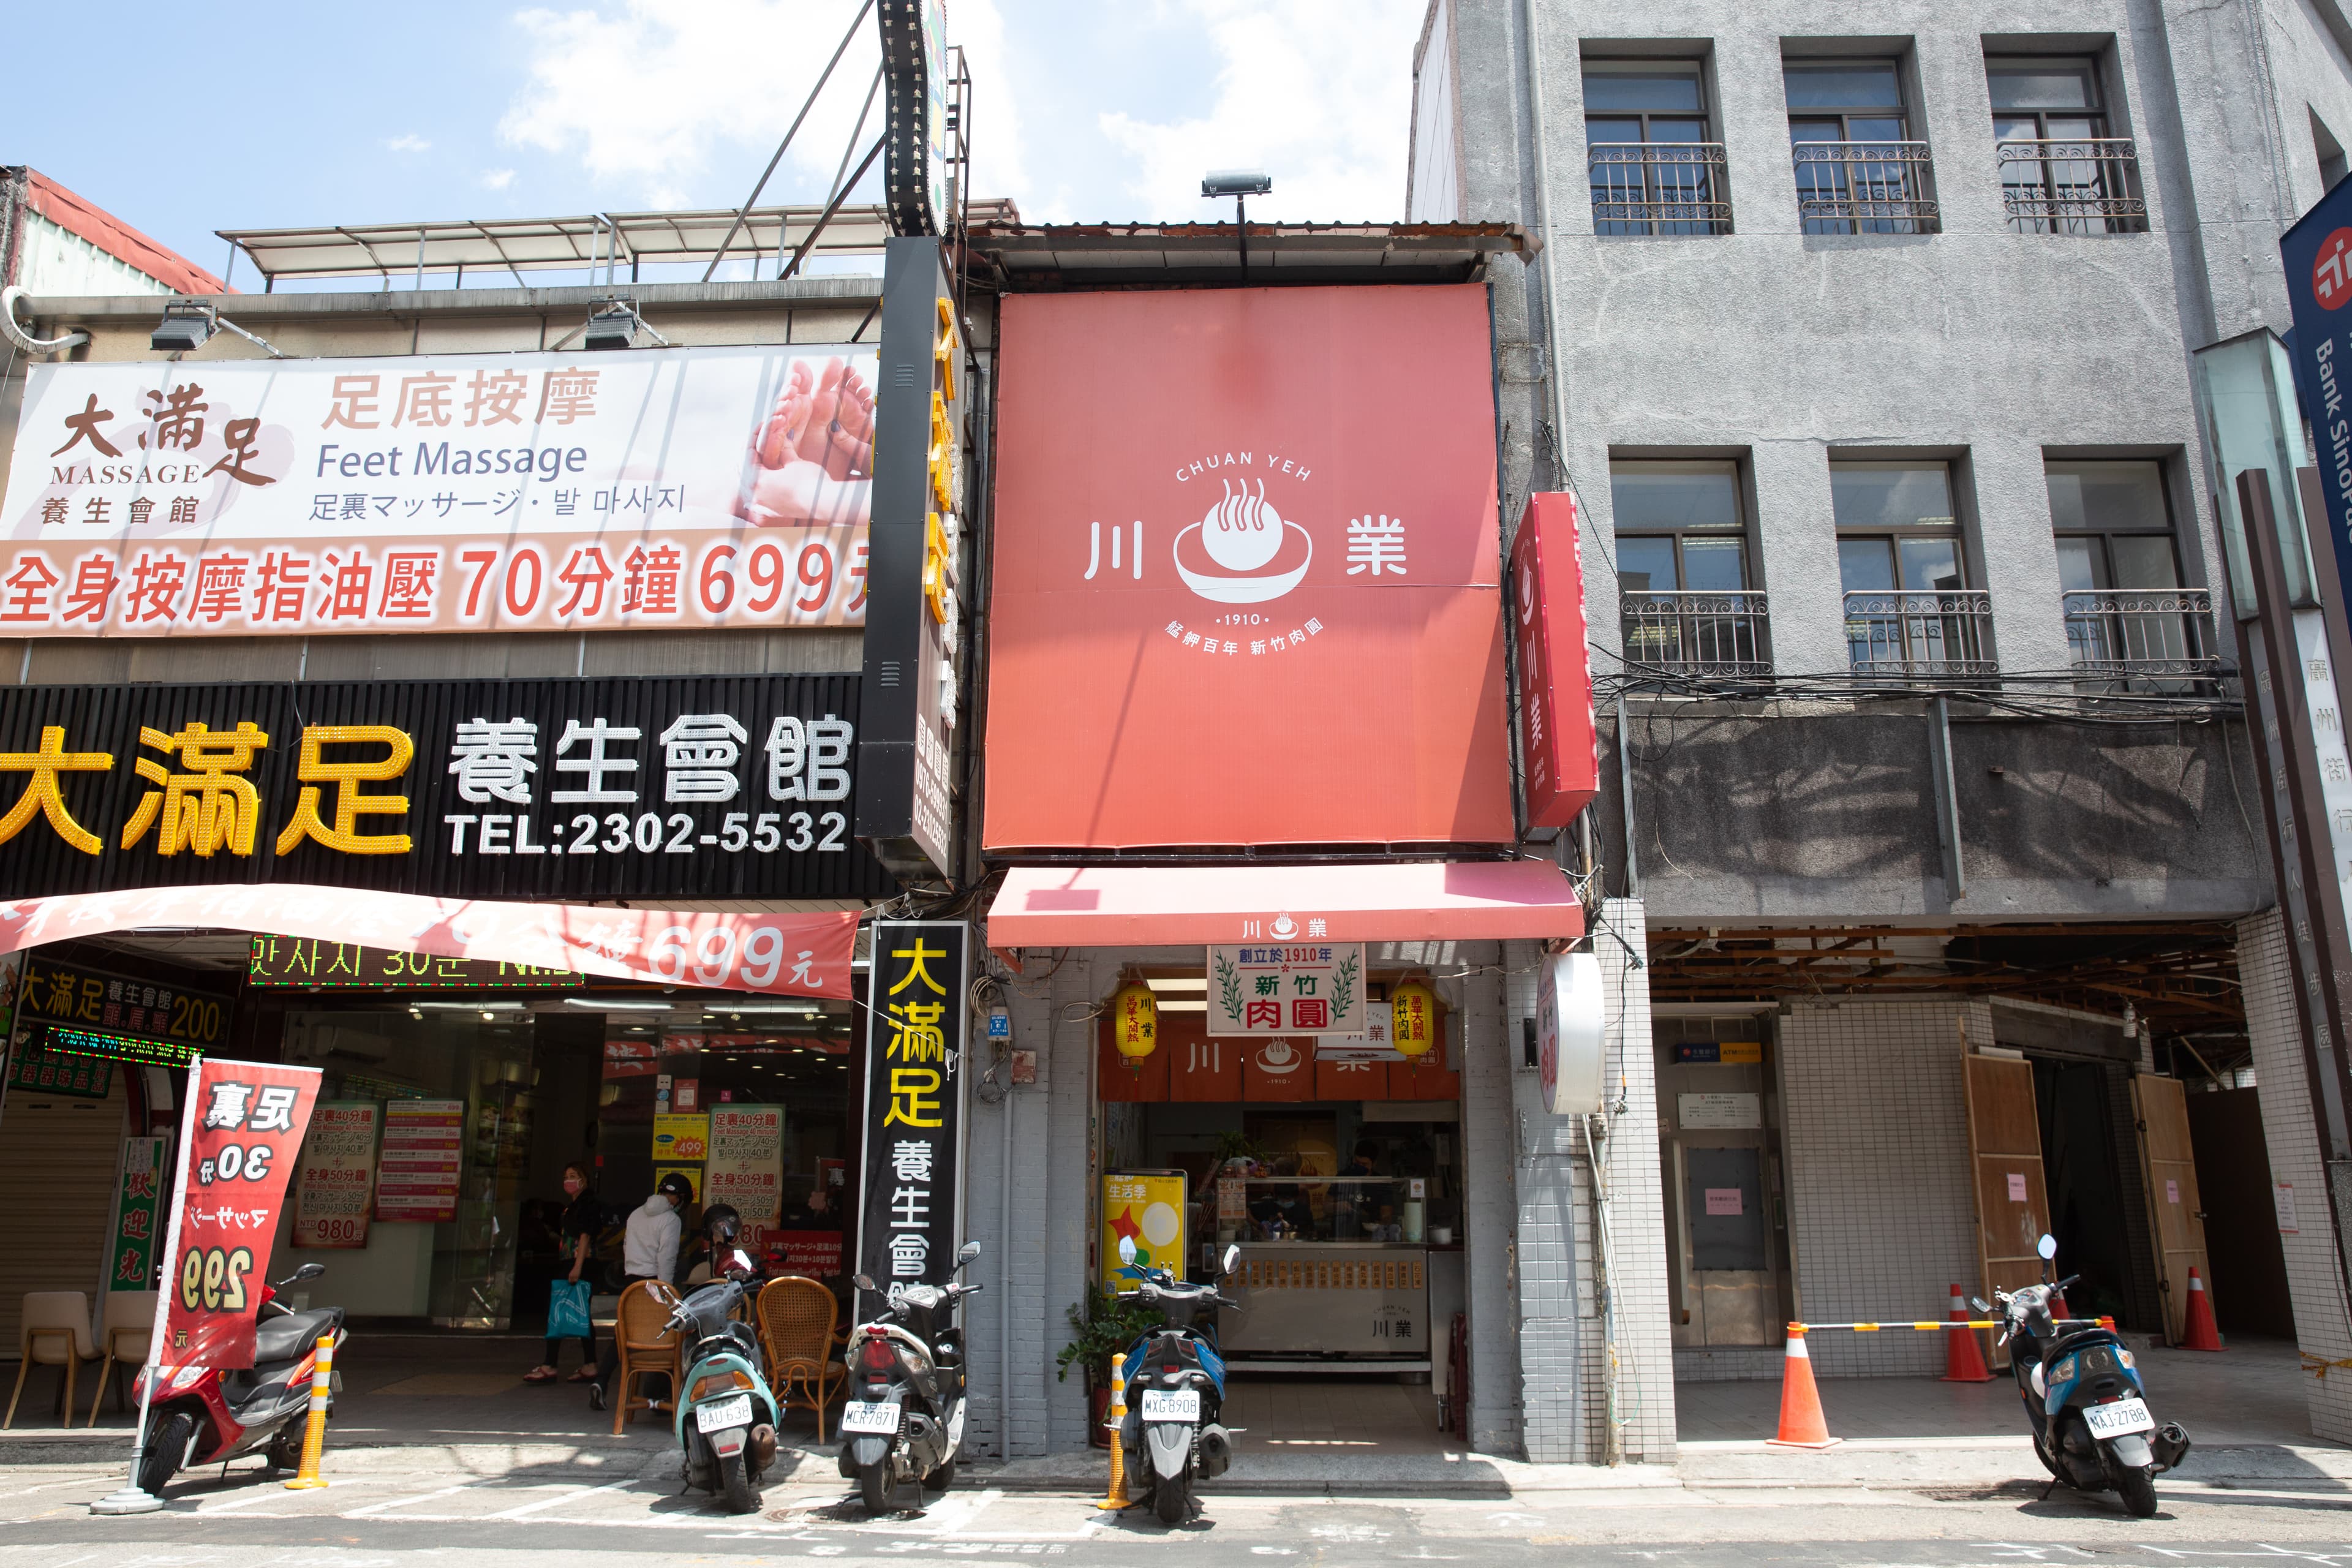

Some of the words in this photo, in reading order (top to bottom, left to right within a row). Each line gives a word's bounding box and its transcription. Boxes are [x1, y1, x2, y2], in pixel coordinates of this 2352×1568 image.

[2316, 337, 2342, 420] Bank
[320, 366, 600, 430] 足底按摩
[50, 383, 277, 486] 大滿足
[50, 465, 201, 484] MASSAGE
[317, 442, 401, 478] Feet
[413, 441, 587, 482] Massage
[1176, 451, 1252, 482] CHUAN
[1268, 454, 1311, 482] YEH
[40, 496, 200, 526] 養生會館
[593, 484, 685, 514] 마사지
[1164, 619, 1238, 656] 艋舺百年
[1250, 616, 1324, 655] 新竹肉圓
[448, 714, 853, 805] 養生會館
[0, 721, 414, 856] 大滿足
[444, 812, 847, 855] TEL:2302-5532
[1238, 948, 1332, 963] 創立於1910年
[20, 967, 104, 1022] 大滿足
[108, 979, 172, 1010] 養生會館
[1256, 975, 1317, 995] 新竹
[169, 995, 219, 1042] 200
[1247, 999, 1328, 1028] 肉圓
[884, 938, 946, 1128] 大滿足
[312, 1109, 373, 1122] 足裏40分鐘
[715, 1113, 778, 1127] 足裏40分鐘
[306, 1169, 367, 1182] 全身50分鐘
[712, 1173, 775, 1186] 全身50分鐘
[1109, 1183, 1147, 1199] 生活季
[300, 1219, 316, 1228] NTD
